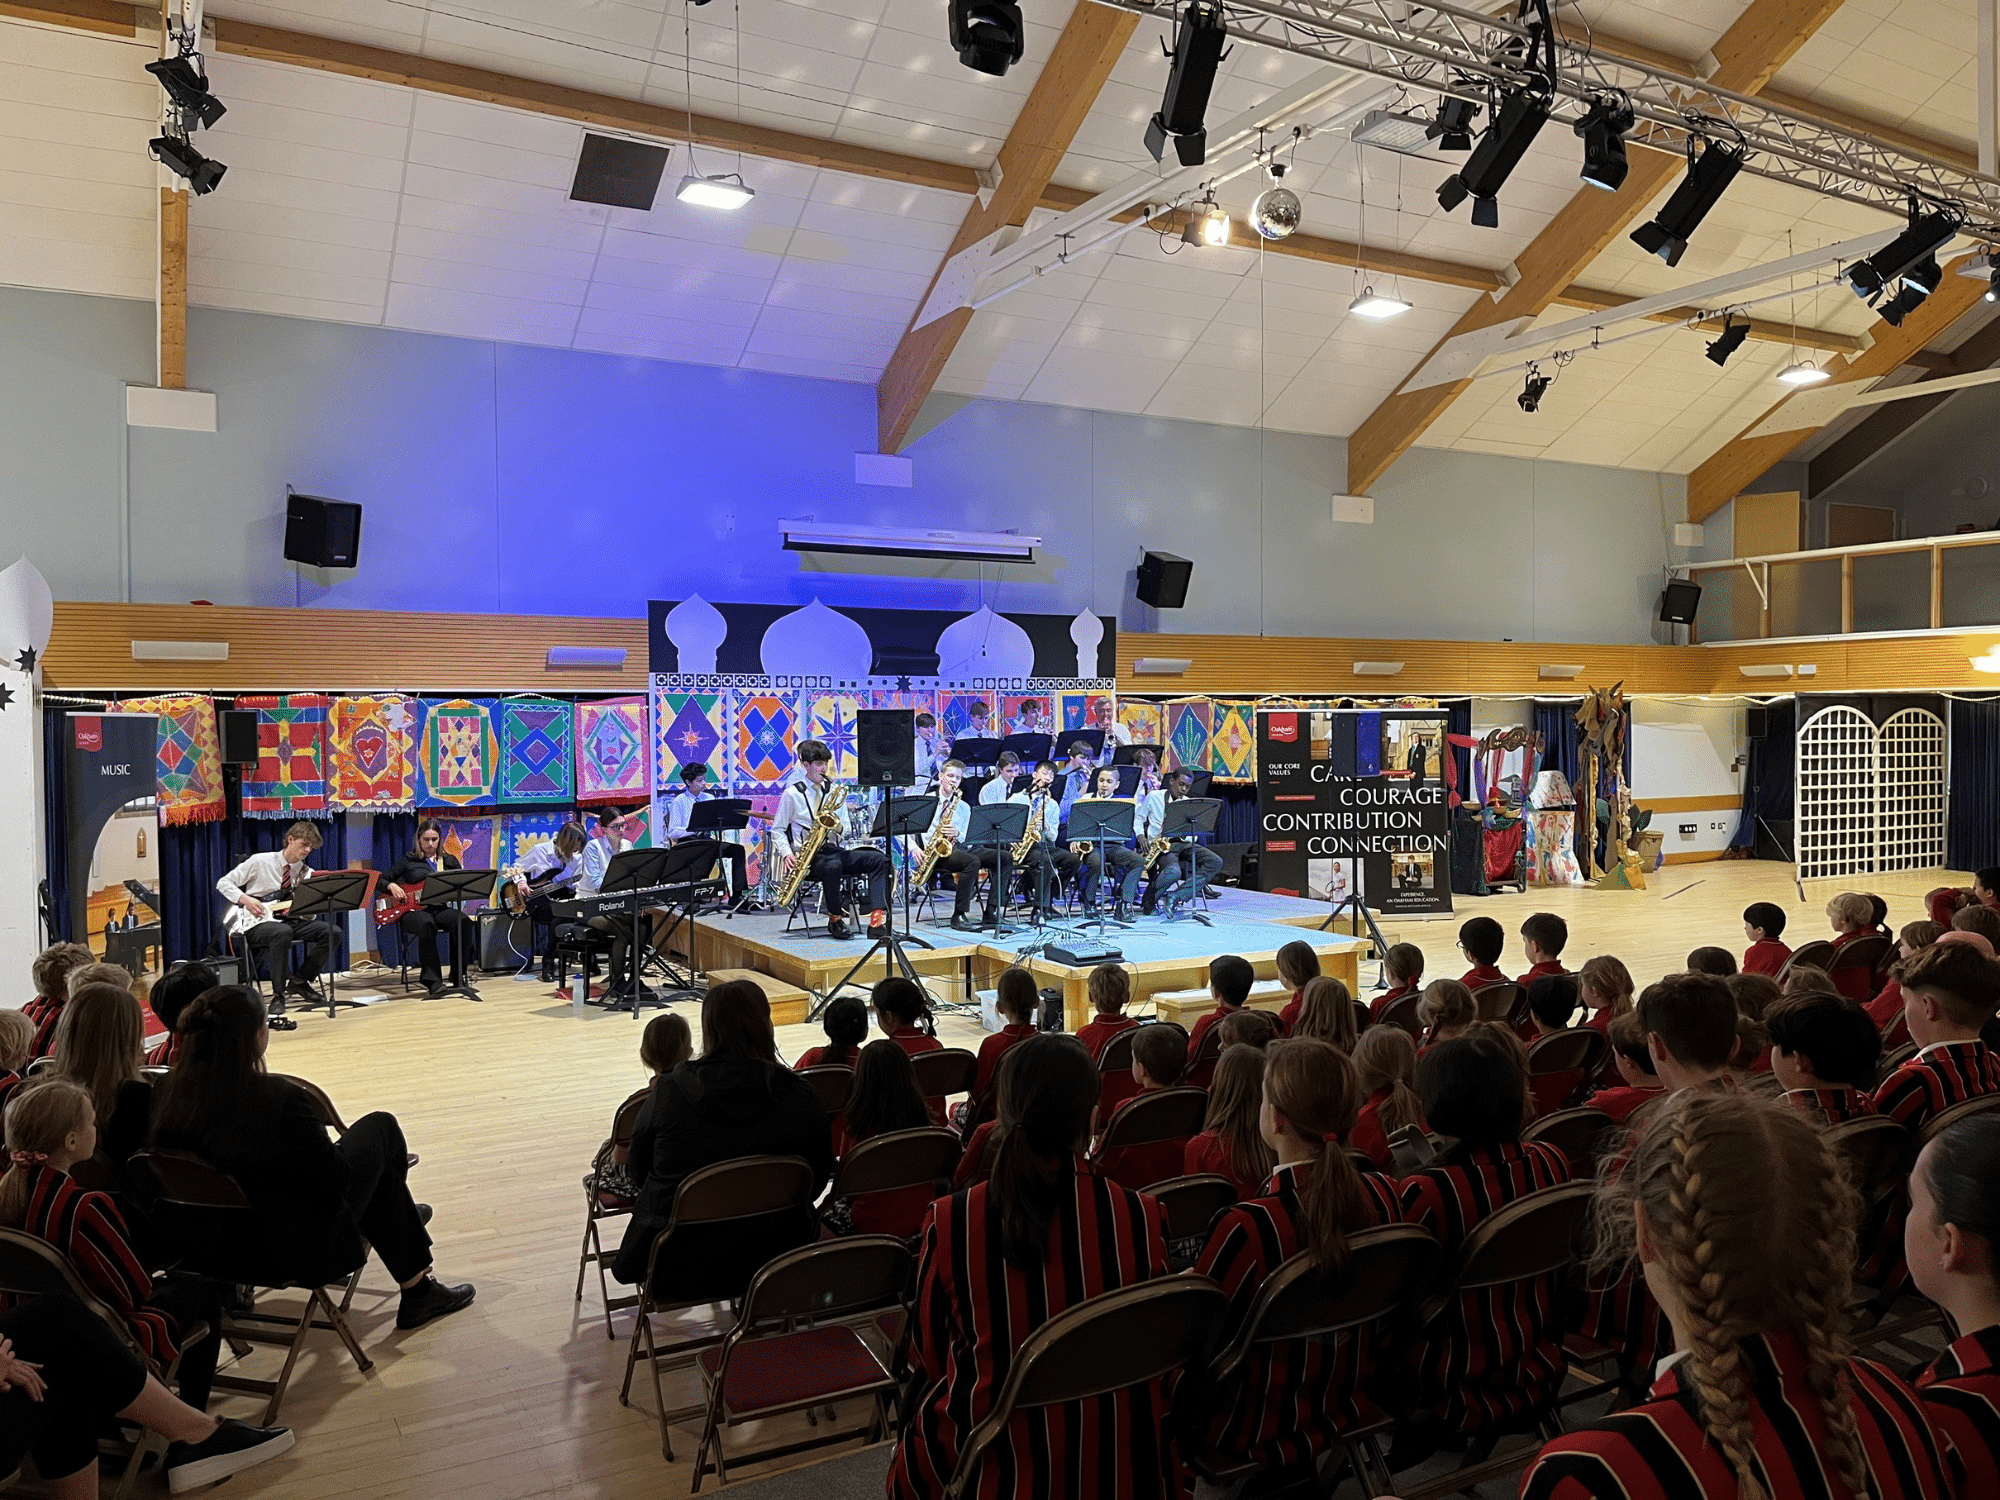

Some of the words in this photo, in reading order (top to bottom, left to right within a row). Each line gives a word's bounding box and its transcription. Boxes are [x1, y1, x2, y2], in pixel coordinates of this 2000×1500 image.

[1271, 726, 1295, 735] Oakham
[101, 764, 131, 775] MUSIC
[1340, 787, 1442, 805] COURAGE
[1263, 811, 1422, 832] CONTRIBUTION
[1307, 834, 1447, 854] CONNECTION
[694, 887, 715, 897] FP-7
[598, 900, 625, 912] Roland
